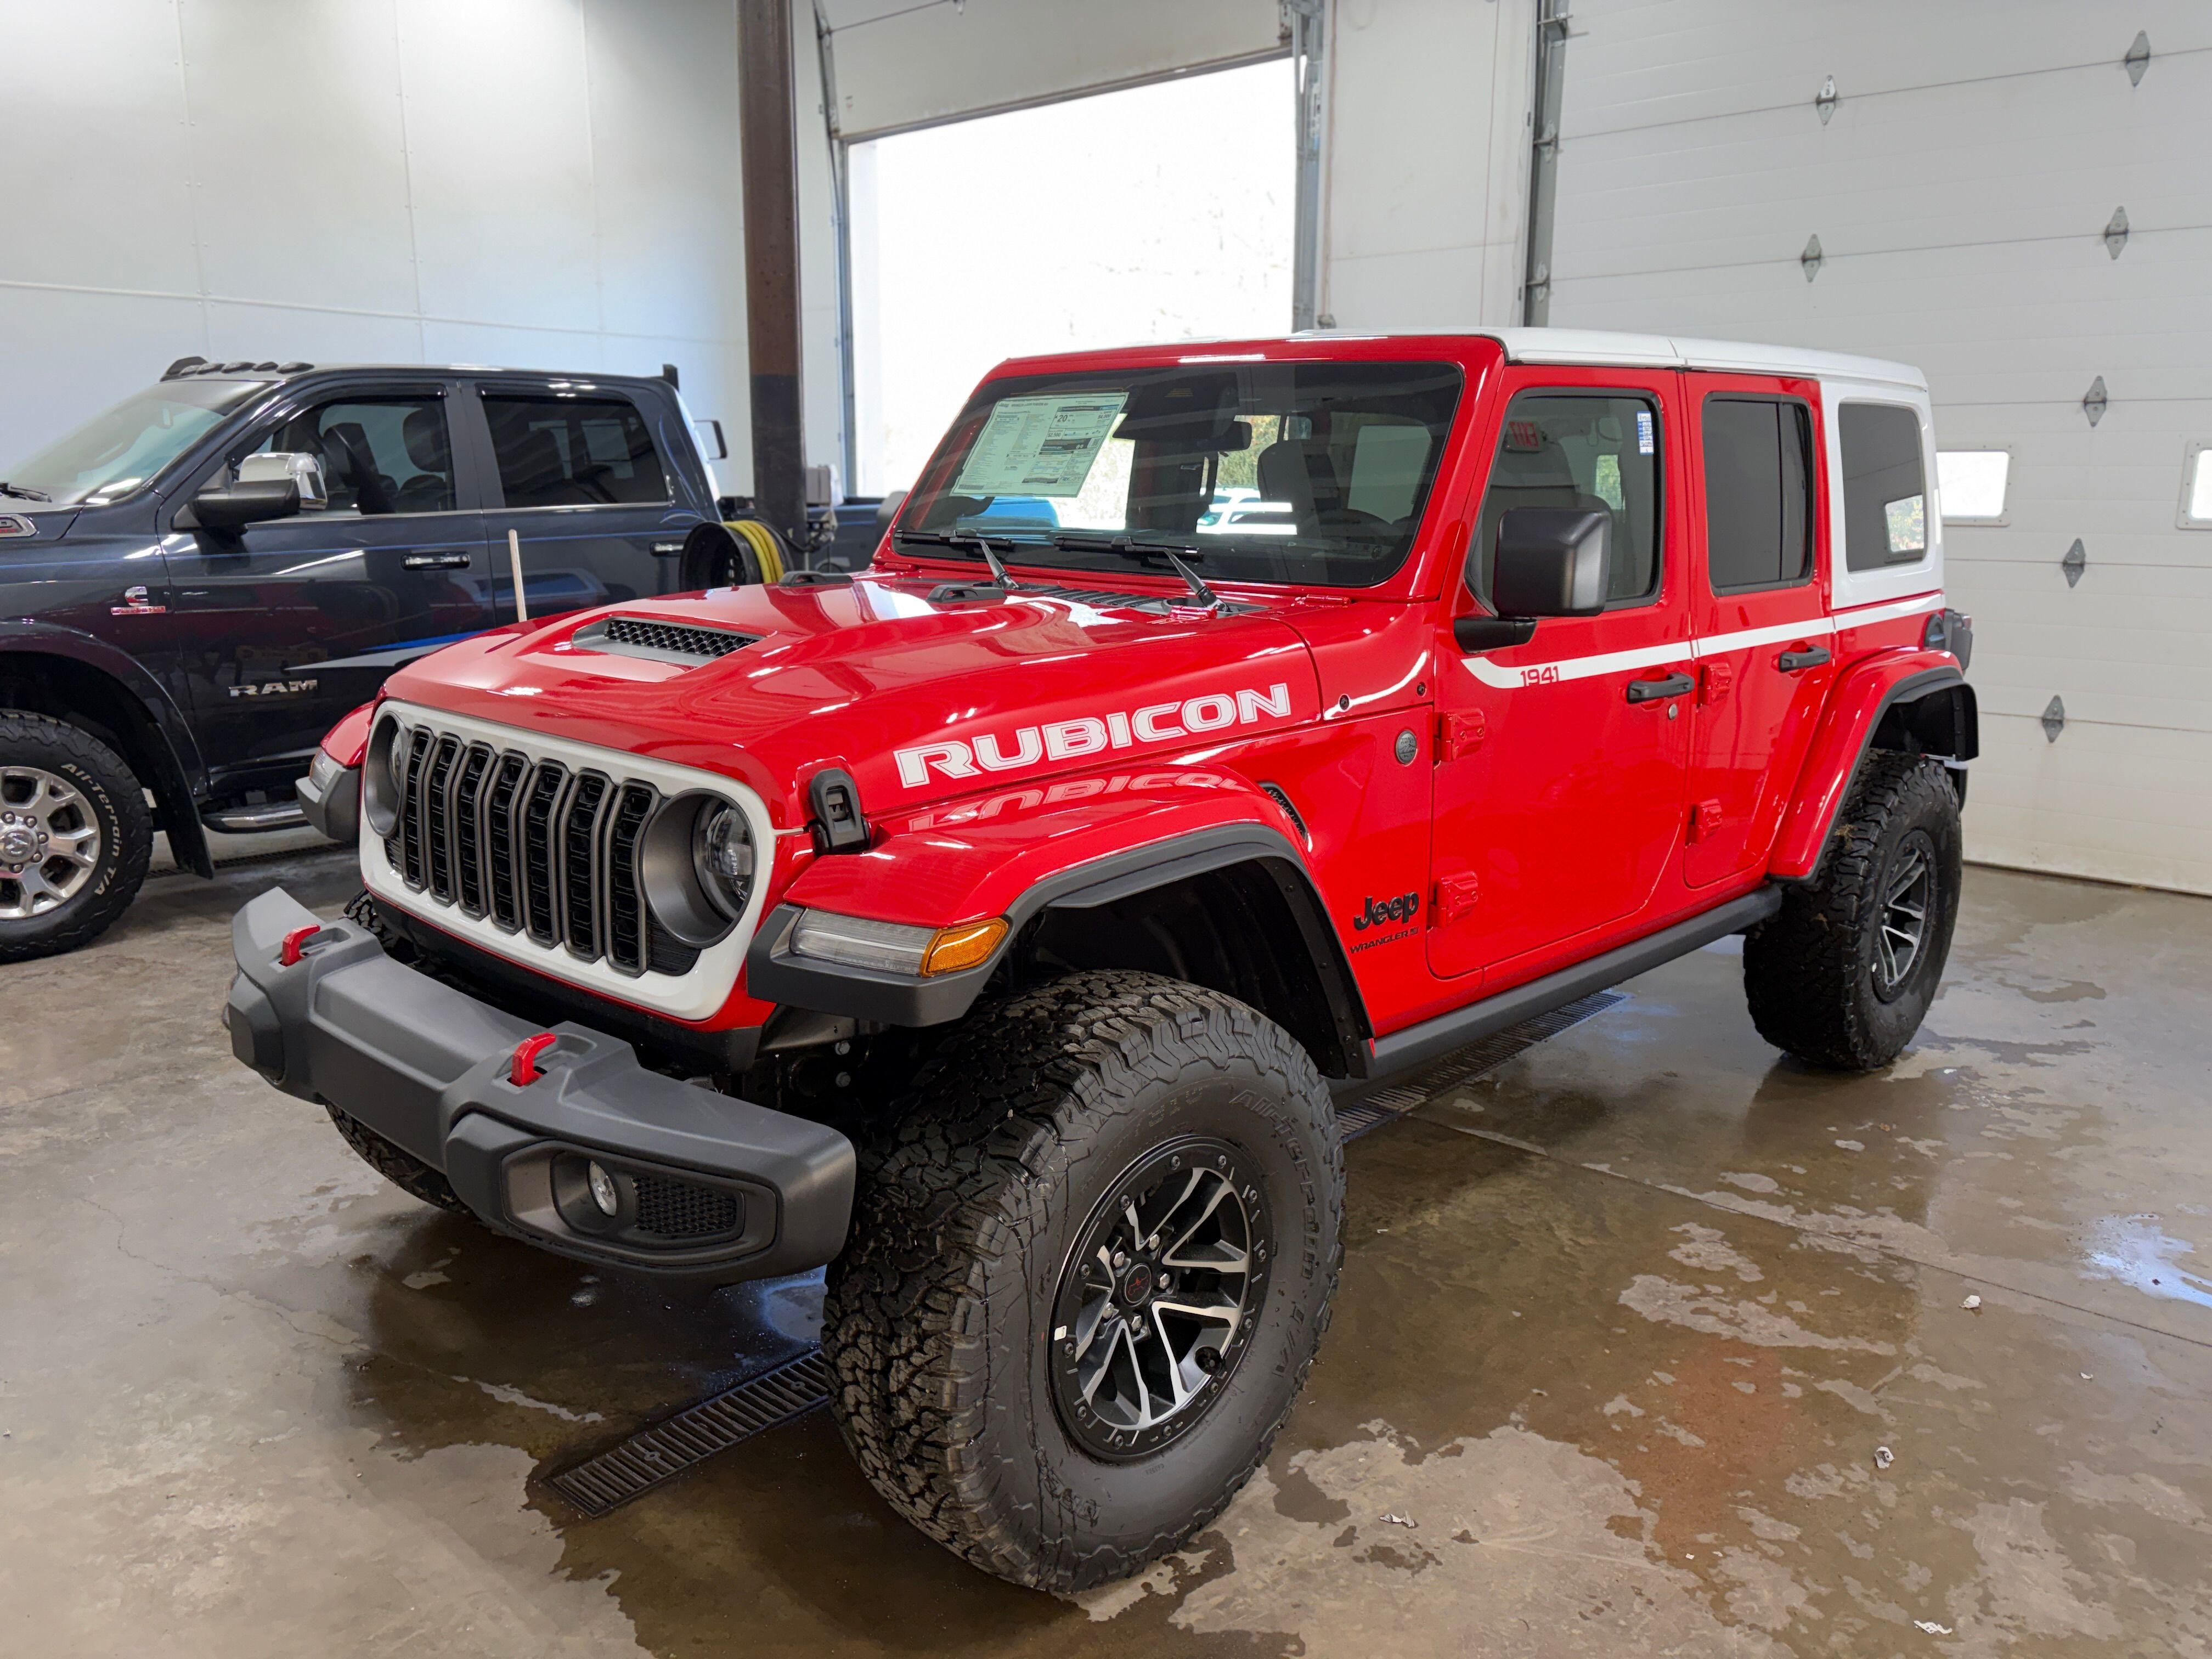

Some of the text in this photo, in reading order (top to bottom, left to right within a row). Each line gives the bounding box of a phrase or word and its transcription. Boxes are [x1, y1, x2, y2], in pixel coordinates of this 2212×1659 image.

[228, 679, 318, 697] RAM
[1520, 665, 1559, 687] 1941
[894, 682, 1291, 789] RUBICON
[61, 763, 123, 895] All-Terrain T/A
[1353, 891, 1419, 930] Jeep
[1350, 930, 1409, 953] WRANGLER
